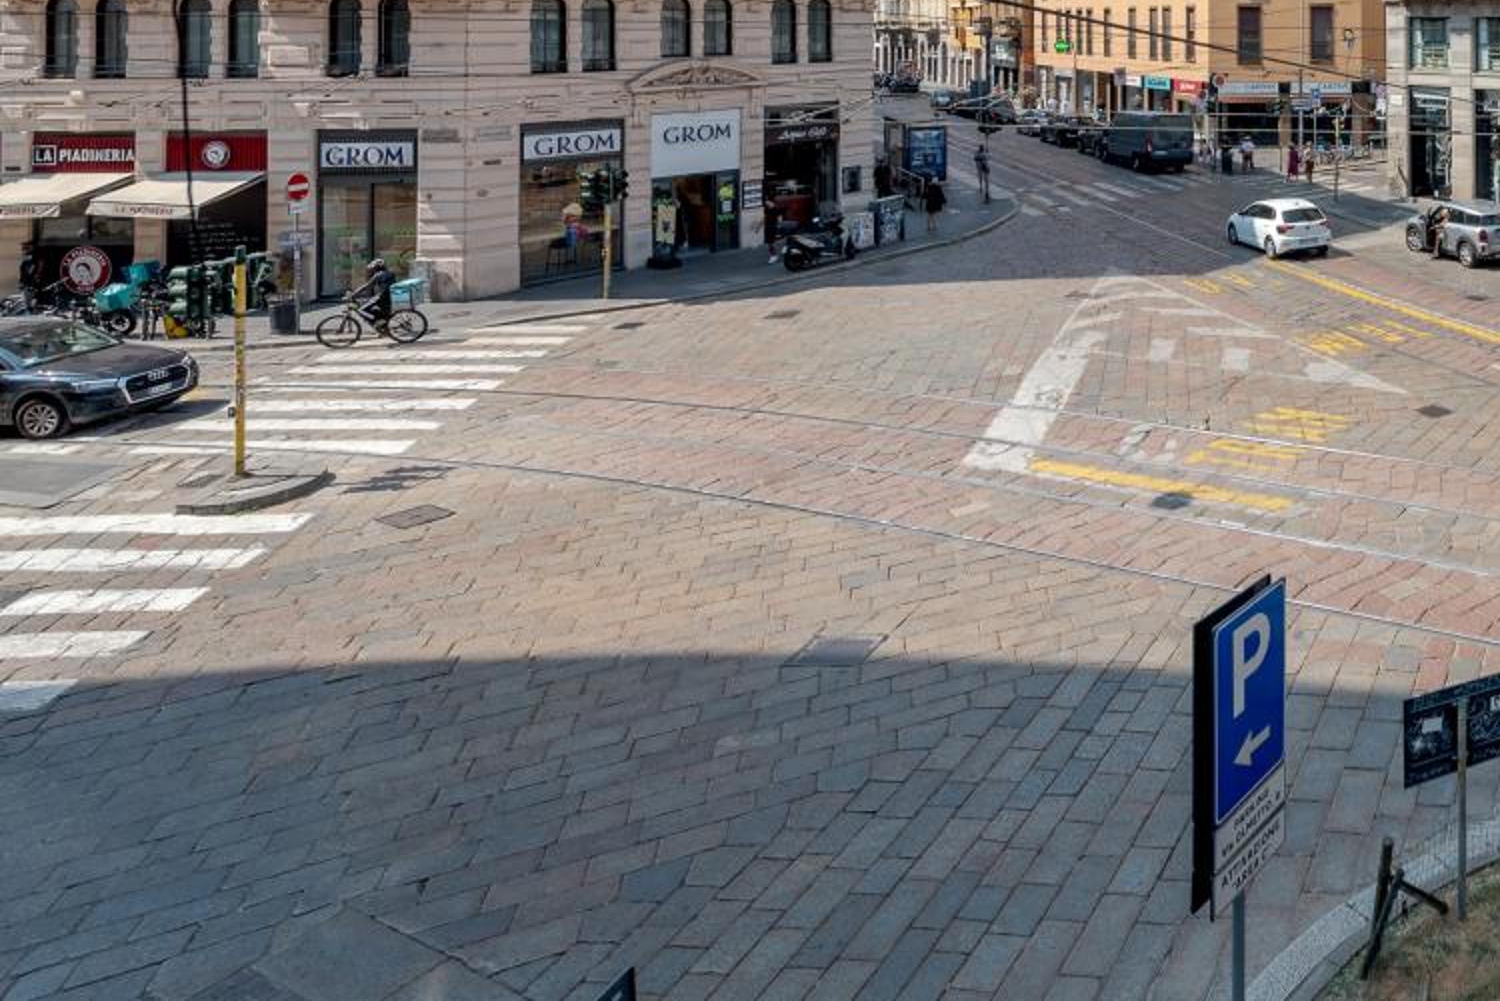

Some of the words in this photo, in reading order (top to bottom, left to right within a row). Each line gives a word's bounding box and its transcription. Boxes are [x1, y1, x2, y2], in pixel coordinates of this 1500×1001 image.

[534, 131, 616, 157] GROM
[663, 123, 731, 144] GROM
[35, 147, 53, 162] LA
[58, 147, 135, 163] PIADINERIA
[325, 146, 405, 166] GROM
[1232, 611, 1271, 719] P
